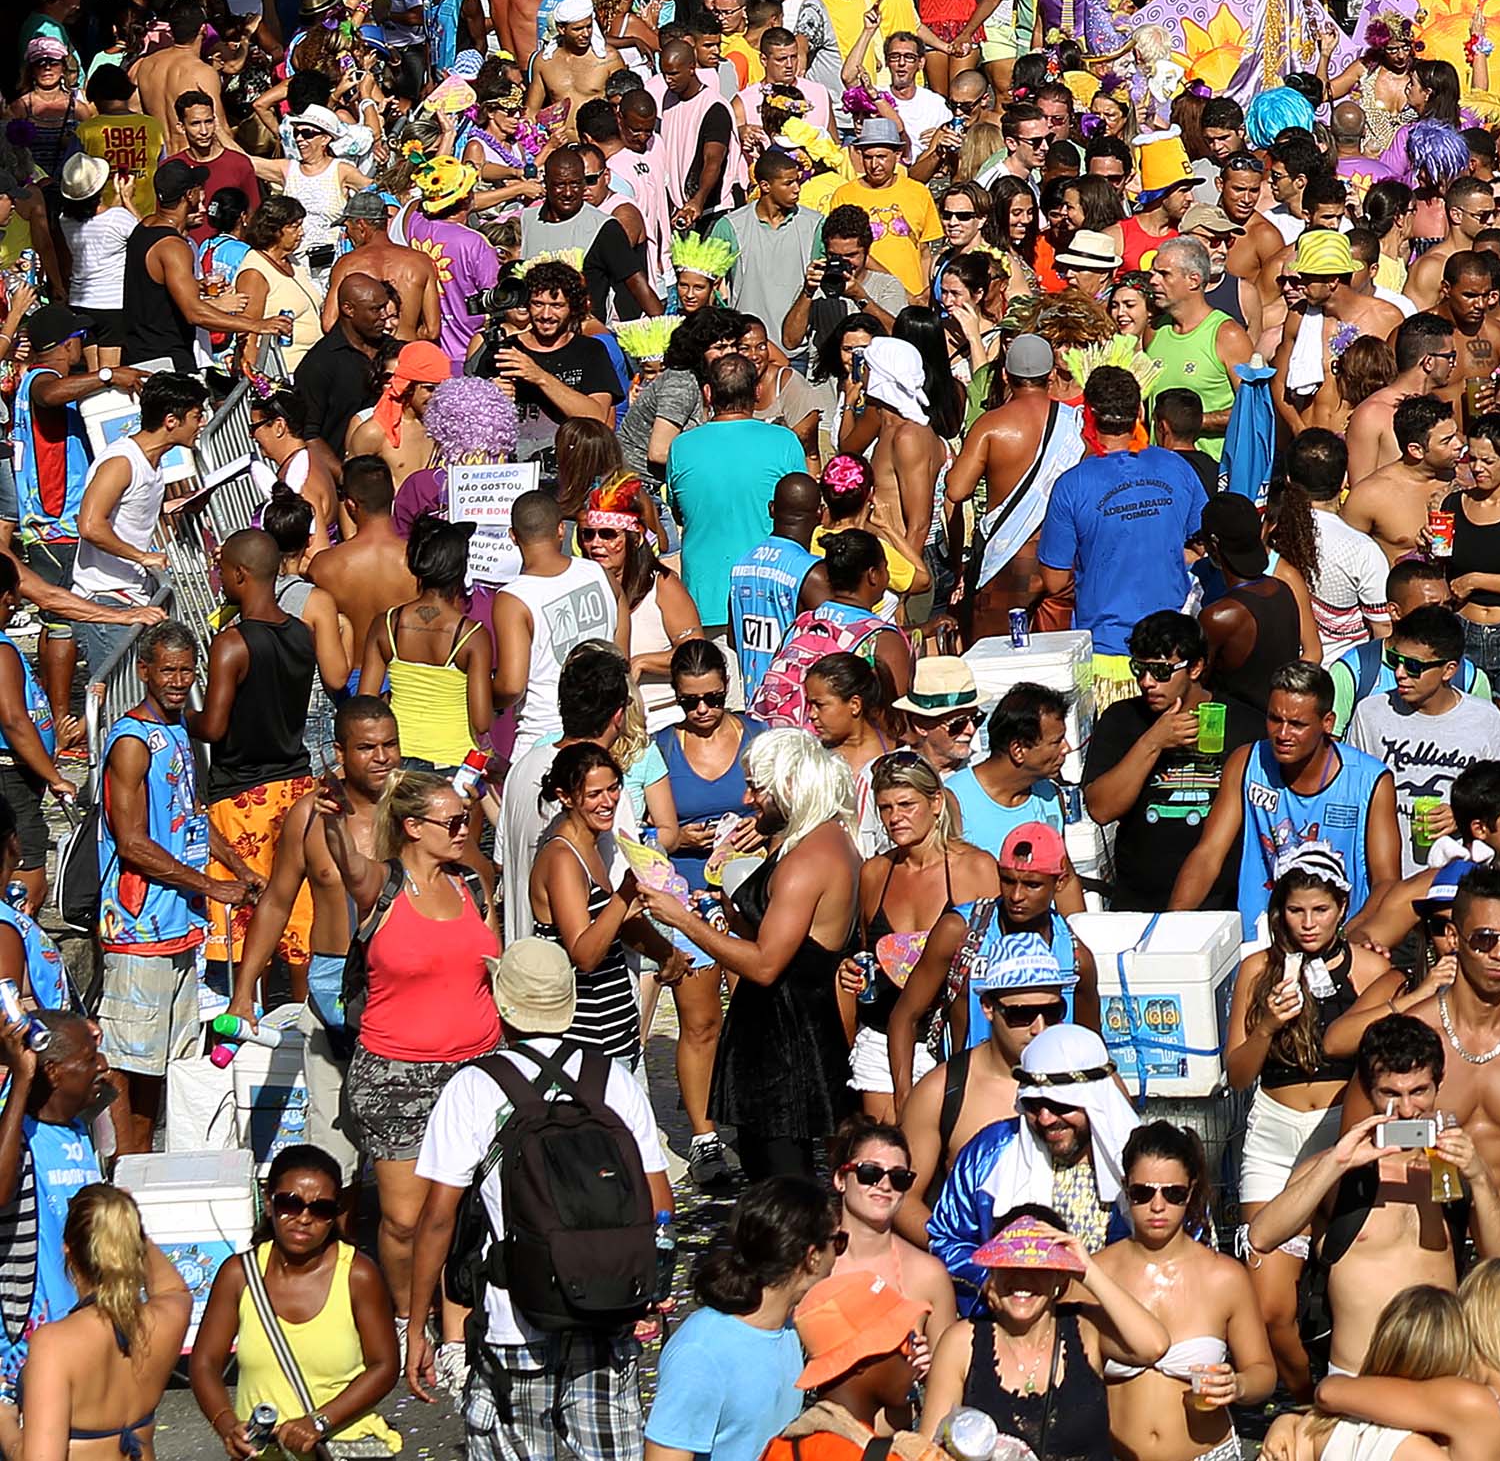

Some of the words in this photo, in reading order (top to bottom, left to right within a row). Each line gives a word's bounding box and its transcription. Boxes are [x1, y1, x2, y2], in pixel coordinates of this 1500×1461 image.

[101, 125, 147, 149] 1984
[103, 148, 147, 169] 2014
[471, 470, 519, 479] MERCADO
[458, 483, 478, 492] NÃO
[468, 495, 496, 504] CARA
[464, 508, 483, 516] SER
[1103, 500, 1138, 517] ADEMIR
[579, 590, 604, 623] 40
